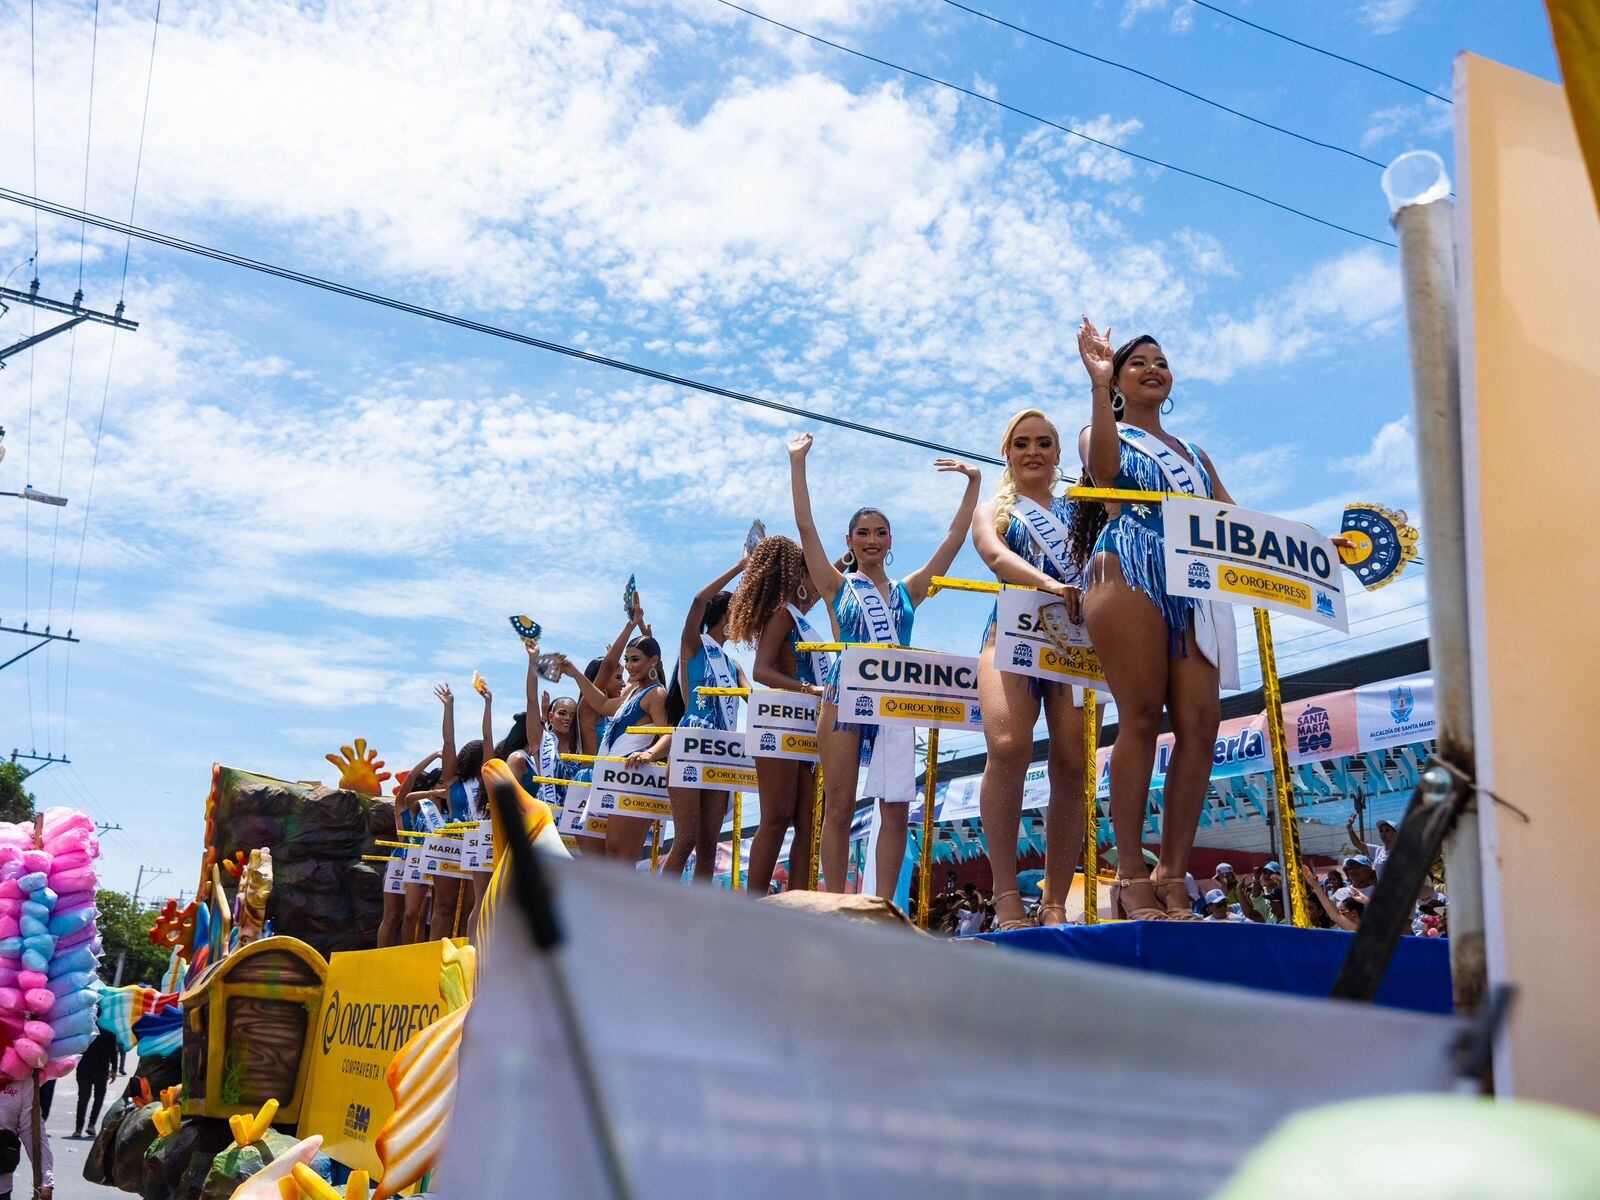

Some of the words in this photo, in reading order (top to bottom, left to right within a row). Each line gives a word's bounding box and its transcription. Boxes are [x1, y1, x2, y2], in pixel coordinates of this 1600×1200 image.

[1025, 510, 1062, 550] VILLA
[1189, 510, 1331, 579] LÍBANO
[1240, 574, 1307, 600] OROEXPRESS
[757, 703, 815, 721] PEREH
[899, 702, 961, 716] OROEXPRESS
[1297, 711, 1329, 726] SANTA
[1298, 721, 1330, 737] MARTA
[1401, 722, 1418, 732] SANTA
[684, 738, 746, 758] PESC
[1298, 732, 1332, 753] 500
[342, 1059, 379, 1080] COMPRAVENTA
[381, 1066, 386, 1081] Y
